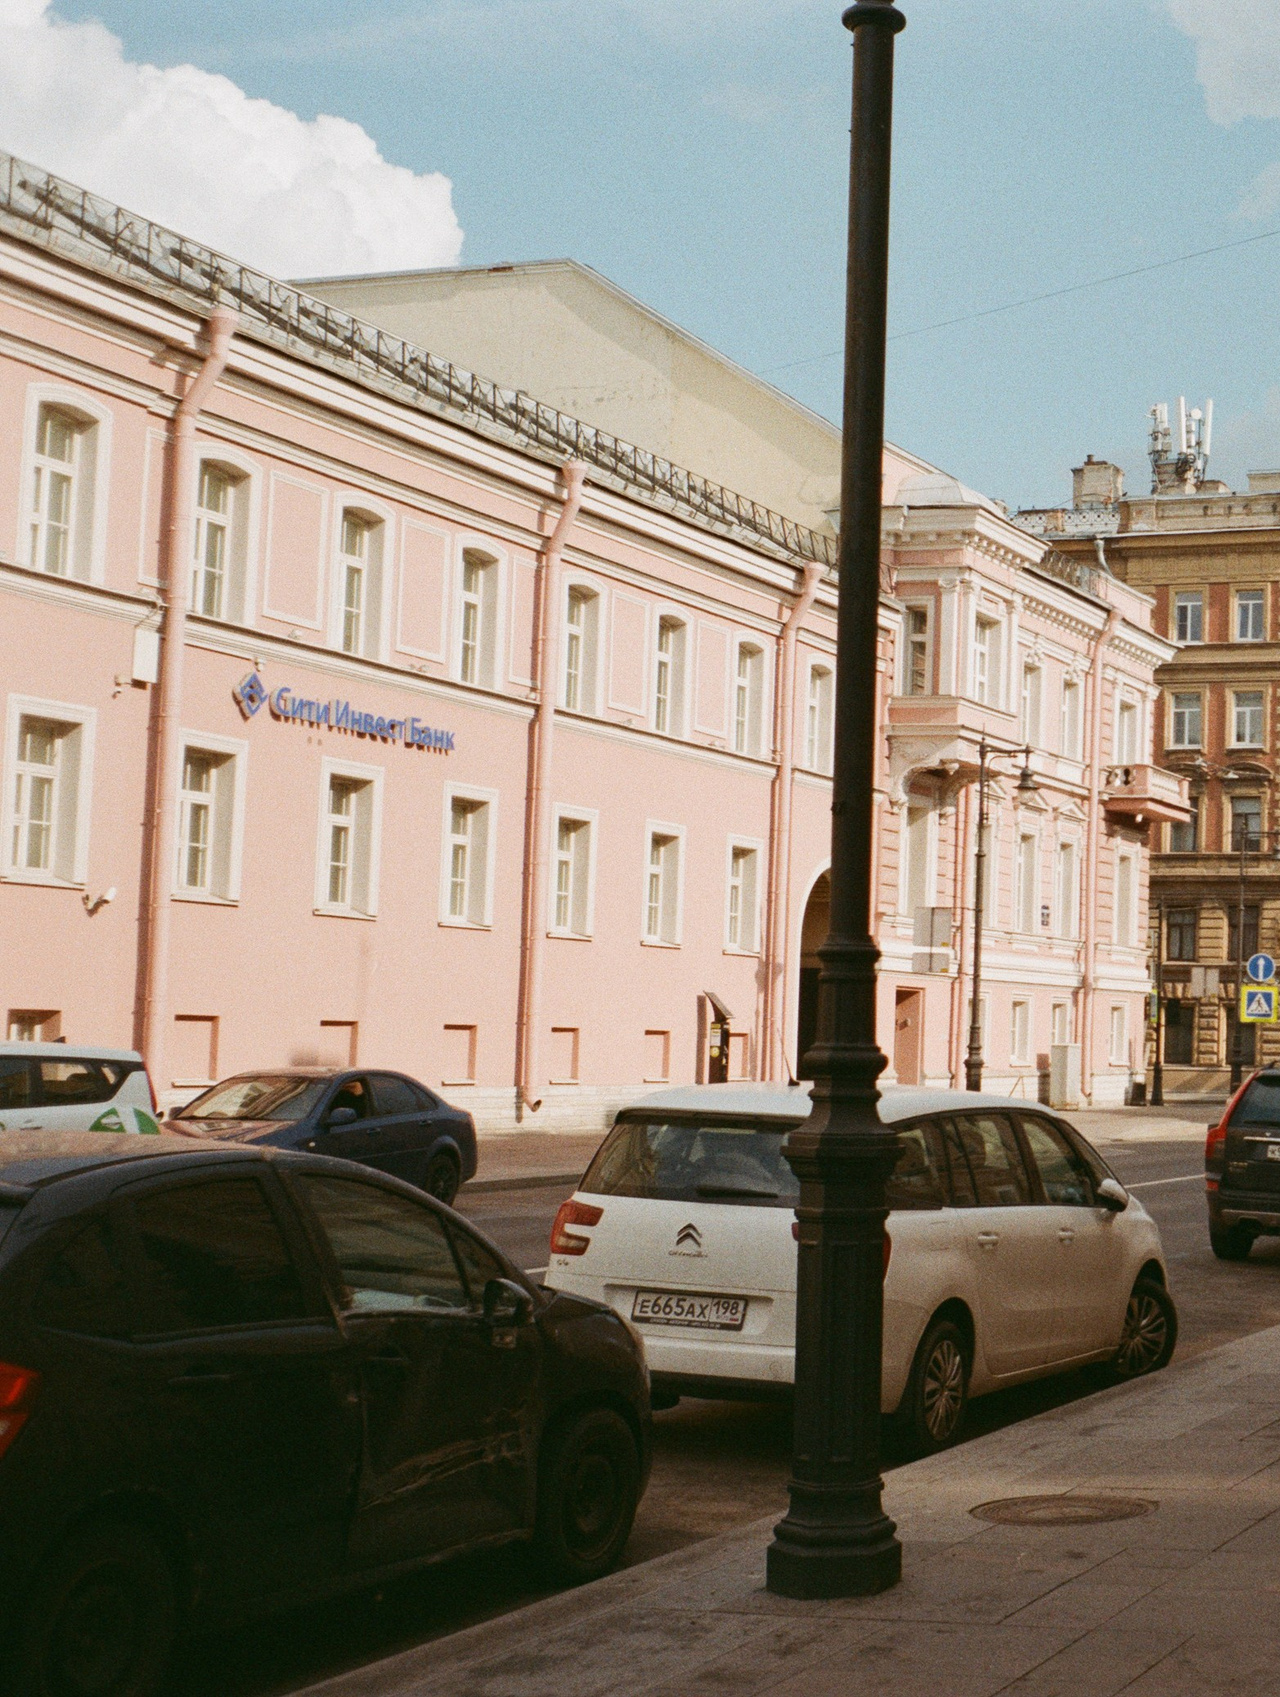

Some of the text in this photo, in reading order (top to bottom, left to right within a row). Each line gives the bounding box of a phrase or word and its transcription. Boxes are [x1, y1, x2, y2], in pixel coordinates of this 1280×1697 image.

[270, 686, 456, 751] Сити Инвест Банк
[713, 1300, 740, 1317] 198
